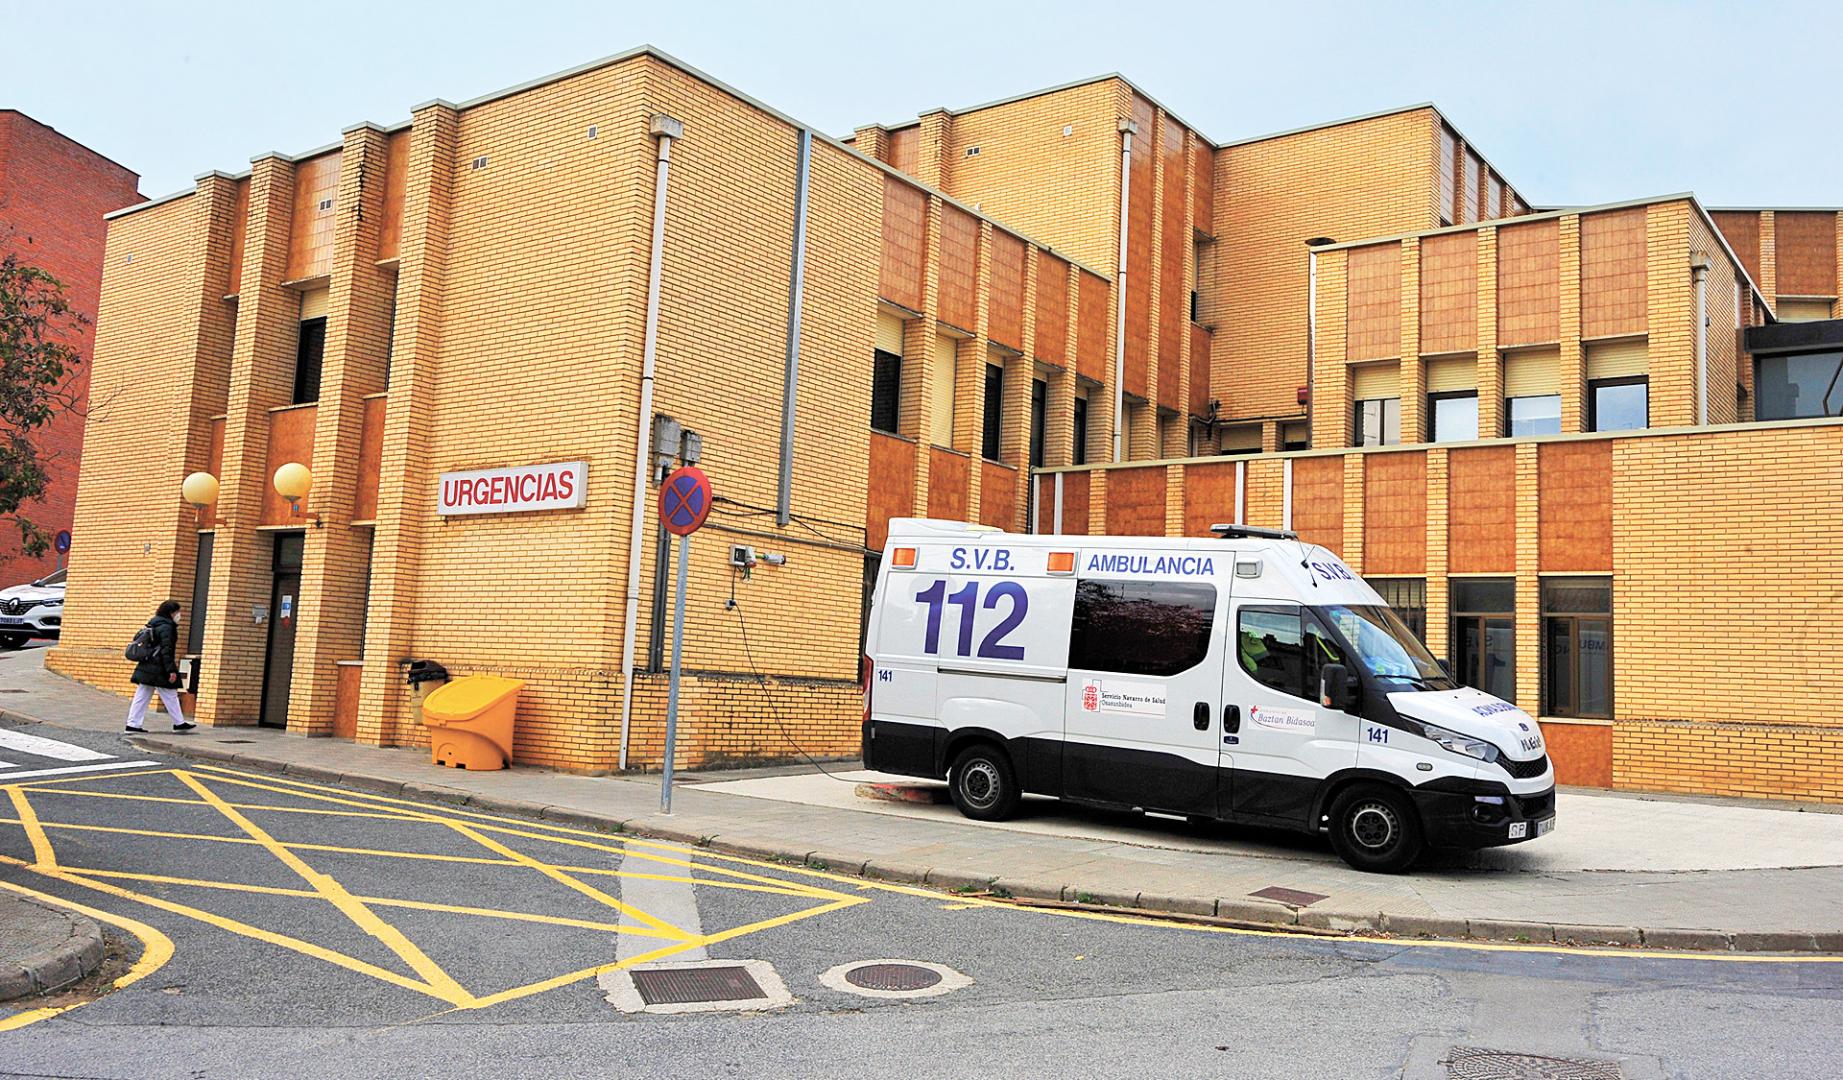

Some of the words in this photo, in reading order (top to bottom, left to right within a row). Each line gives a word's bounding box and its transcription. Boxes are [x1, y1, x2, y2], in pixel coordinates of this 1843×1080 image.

[443, 470, 575, 507] URGENCIAS
[949, 547, 1016, 571] S.V.B.
[1087, 554, 1215, 576] AMBULANCIA
[915, 579, 1030, 661] 112
[877, 670, 893, 682] 141
[1101, 692, 1121, 700] Servicio
[1122, 694, 1144, 702] Navarro
[1258, 713, 1284, 724] Baztan
[1286, 716, 1315, 727] Bidasoa
[1367, 726, 1389, 744] 141
